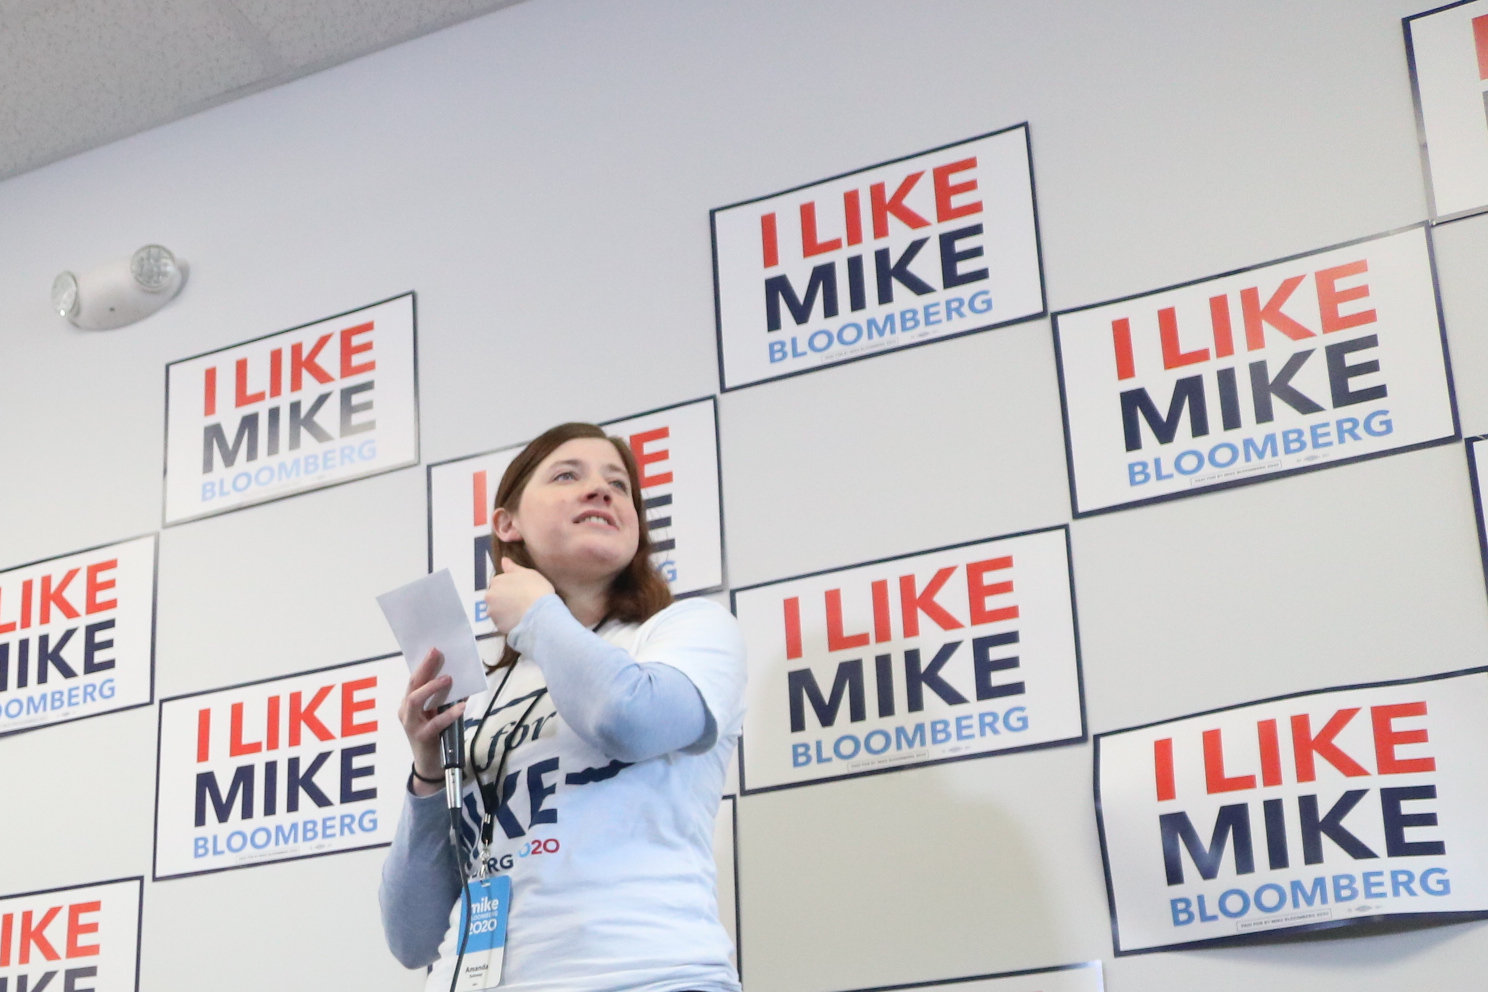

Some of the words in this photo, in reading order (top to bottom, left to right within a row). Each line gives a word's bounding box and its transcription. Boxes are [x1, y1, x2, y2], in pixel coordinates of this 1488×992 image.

[760, 212, 779, 269] I
[799, 157, 984, 259] LIKE
[764, 223, 990, 333] MIKE
[1111, 317, 1136, 381] I
[1157, 259, 1378, 371] LIKE
[204, 366, 217, 417] I
[234, 321, 377, 408] LIKE
[767, 289, 993, 365] BLOOMBERG
[202, 380, 376, 474] MIKE
[1119, 334, 1388, 453] MIKE
[200, 439, 377, 502] BLOOMBERG
[1127, 409, 1393, 487] BLOOMBERG
[472, 470, 488, 527] I
[783, 596, 803, 660] I
[824, 555, 1020, 653] LIKE
[196, 707, 212, 764] I
[229, 675, 379, 758] LIKE
[787, 630, 1026, 734] MIKE
[475, 711, 557, 772] for
[791, 706, 1030, 768] BLOOMBERG
[1153, 737, 1177, 802] I
[1202, 701, 1437, 795] LIKE
[194, 742, 378, 828] MIKE
[193, 808, 379, 859] BLOOMBERG
[1158, 784, 1446, 887] MIKE
[1169, 866, 1452, 927] BLOOMBERG
